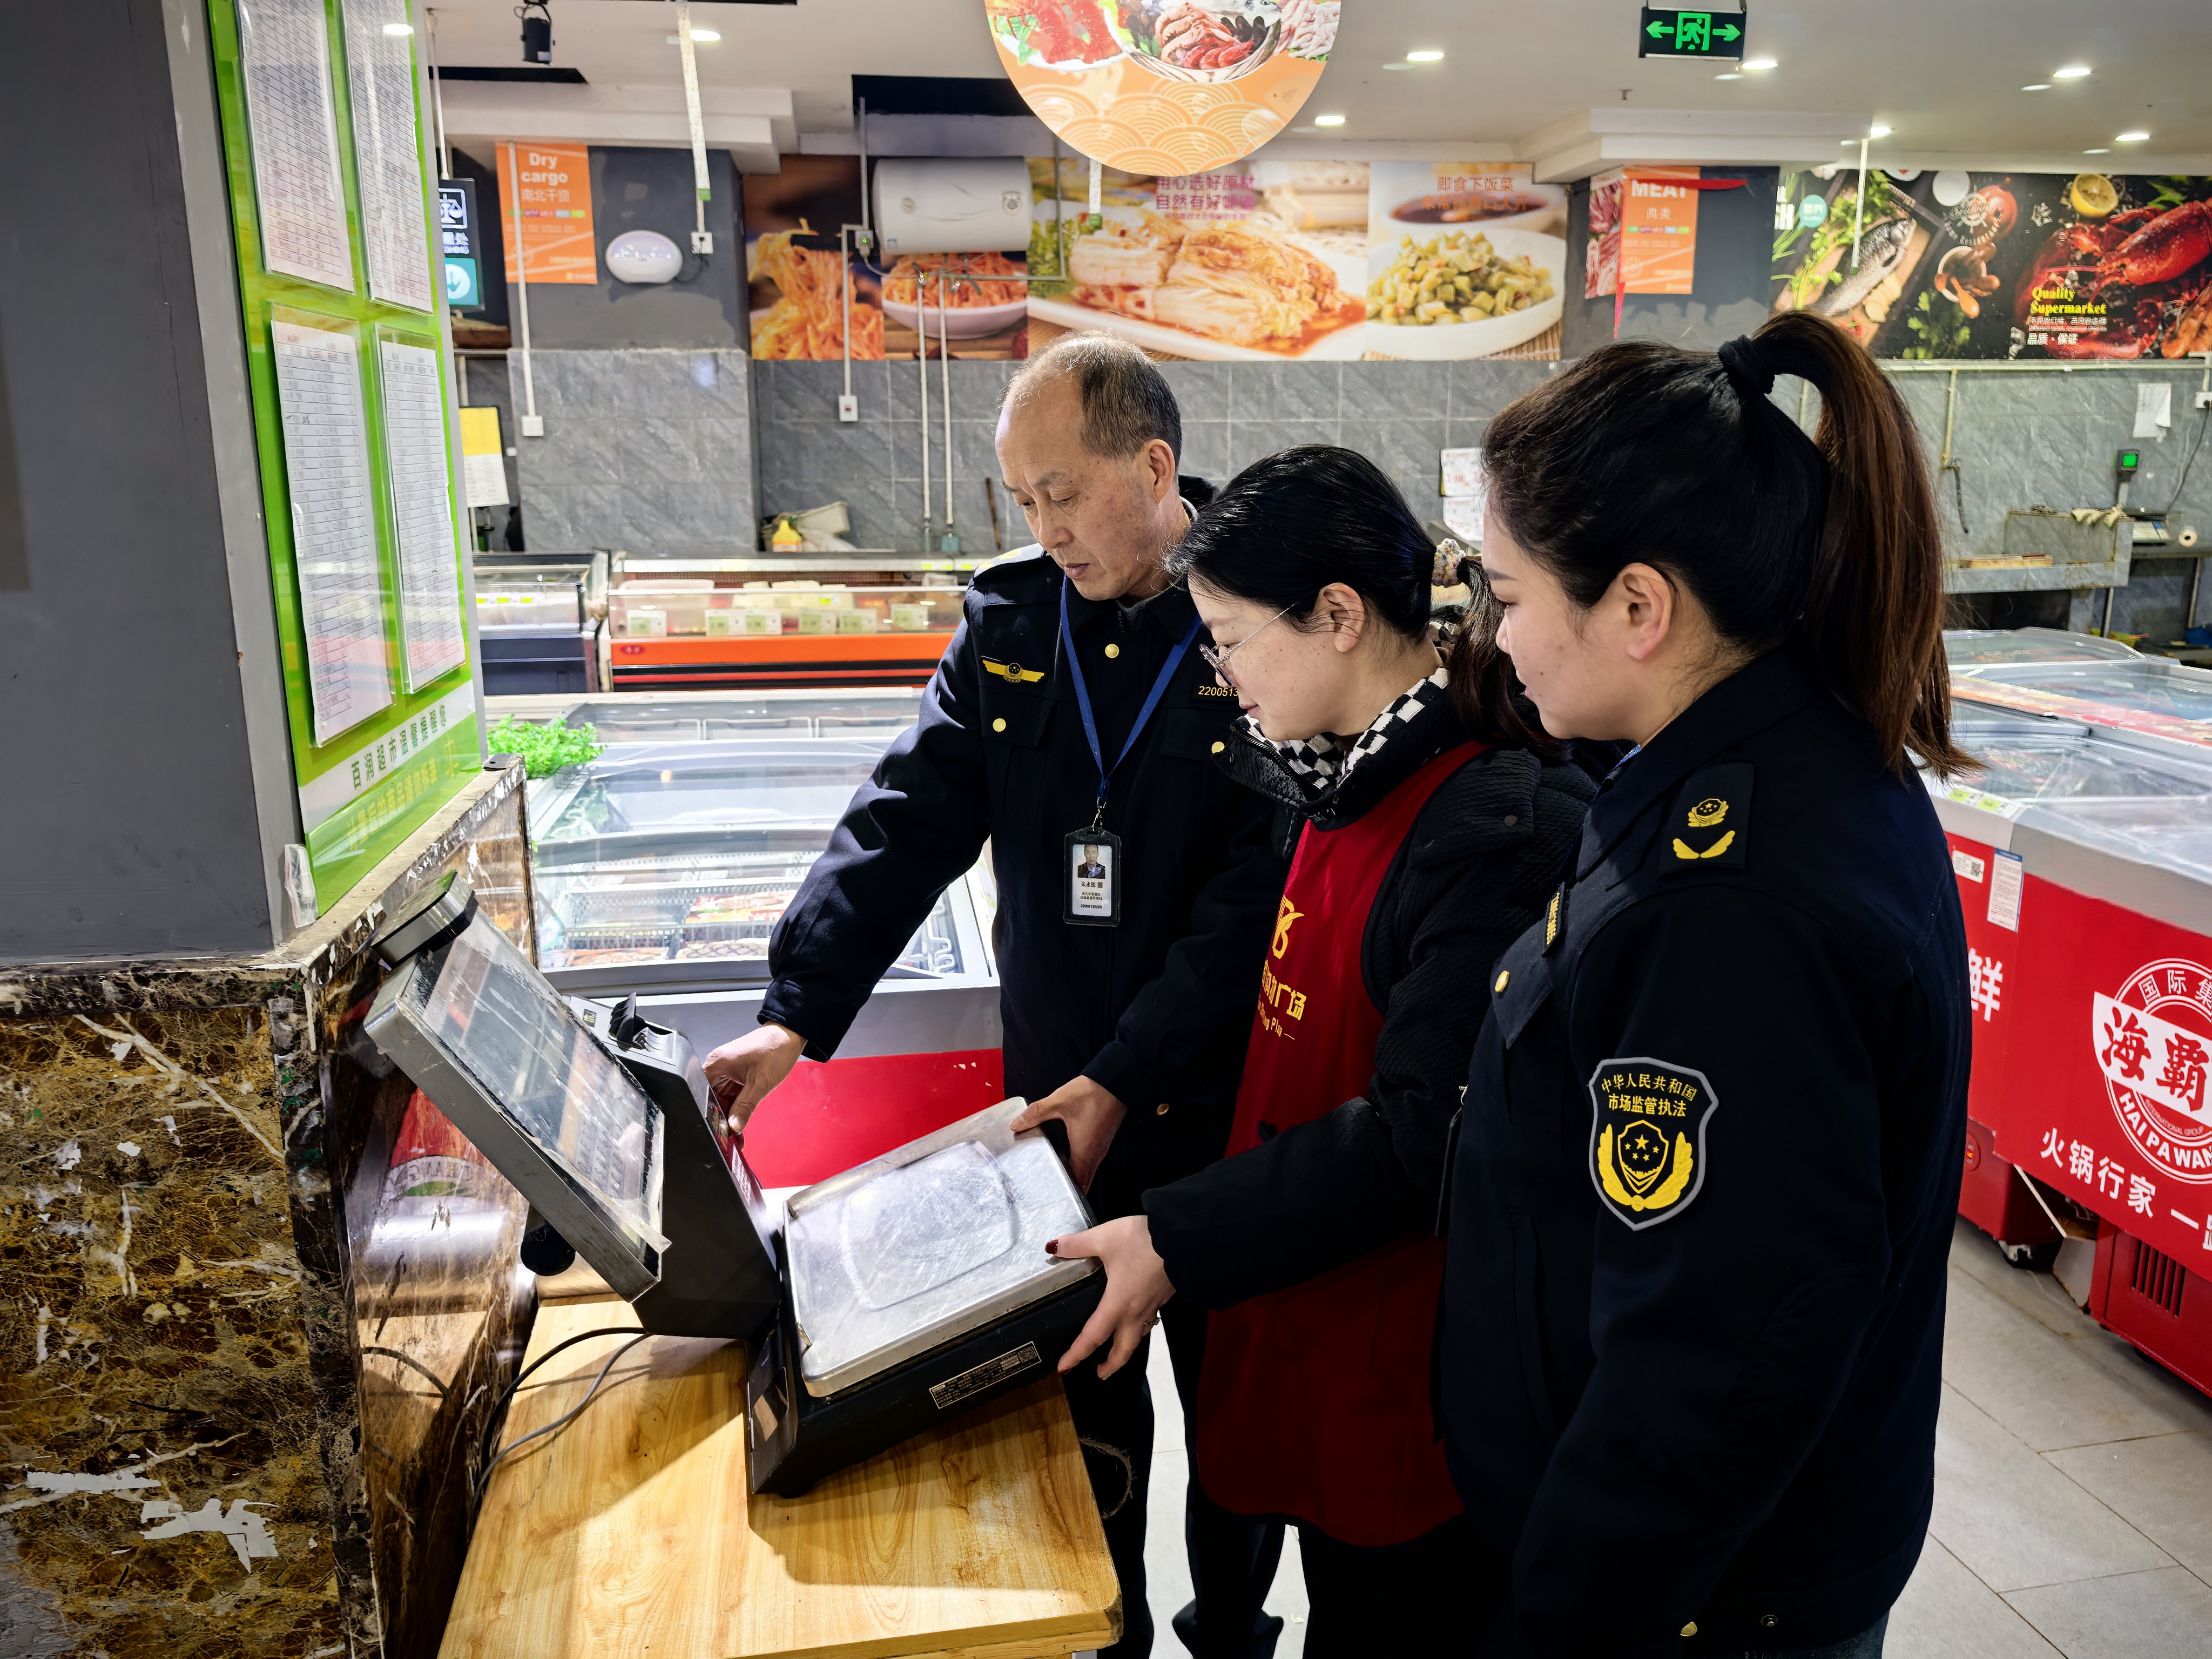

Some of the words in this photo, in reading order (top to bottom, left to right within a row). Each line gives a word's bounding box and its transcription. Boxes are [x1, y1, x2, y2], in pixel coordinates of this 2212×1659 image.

[529, 152, 557, 170] Dry
[521, 172, 568, 186] cargo
[1437, 176, 1515, 192] 即食下饭菜
[522, 188, 570, 203] 南北干货
[1631, 180, 1687, 198] MEAT
[1647, 207, 1671, 220] 肉类
[2032, 287, 2075, 302] Quality
[2030, 301, 2107, 316] Supermarket
[1198, 685, 1239, 697] 2200513
[1968, 948, 2002, 1022] 鲜
[2102, 1006, 2209, 1111] 海霸
[1601, 1073, 1697, 1102] 中华人民共和国
[1608, 1094, 1687, 1117] 市场监管执法
[2120, 1092, 2147, 1137] HAI
[2146, 1131, 2170, 1162] PA
[2040, 1127, 2156, 1218] 火锅行家
